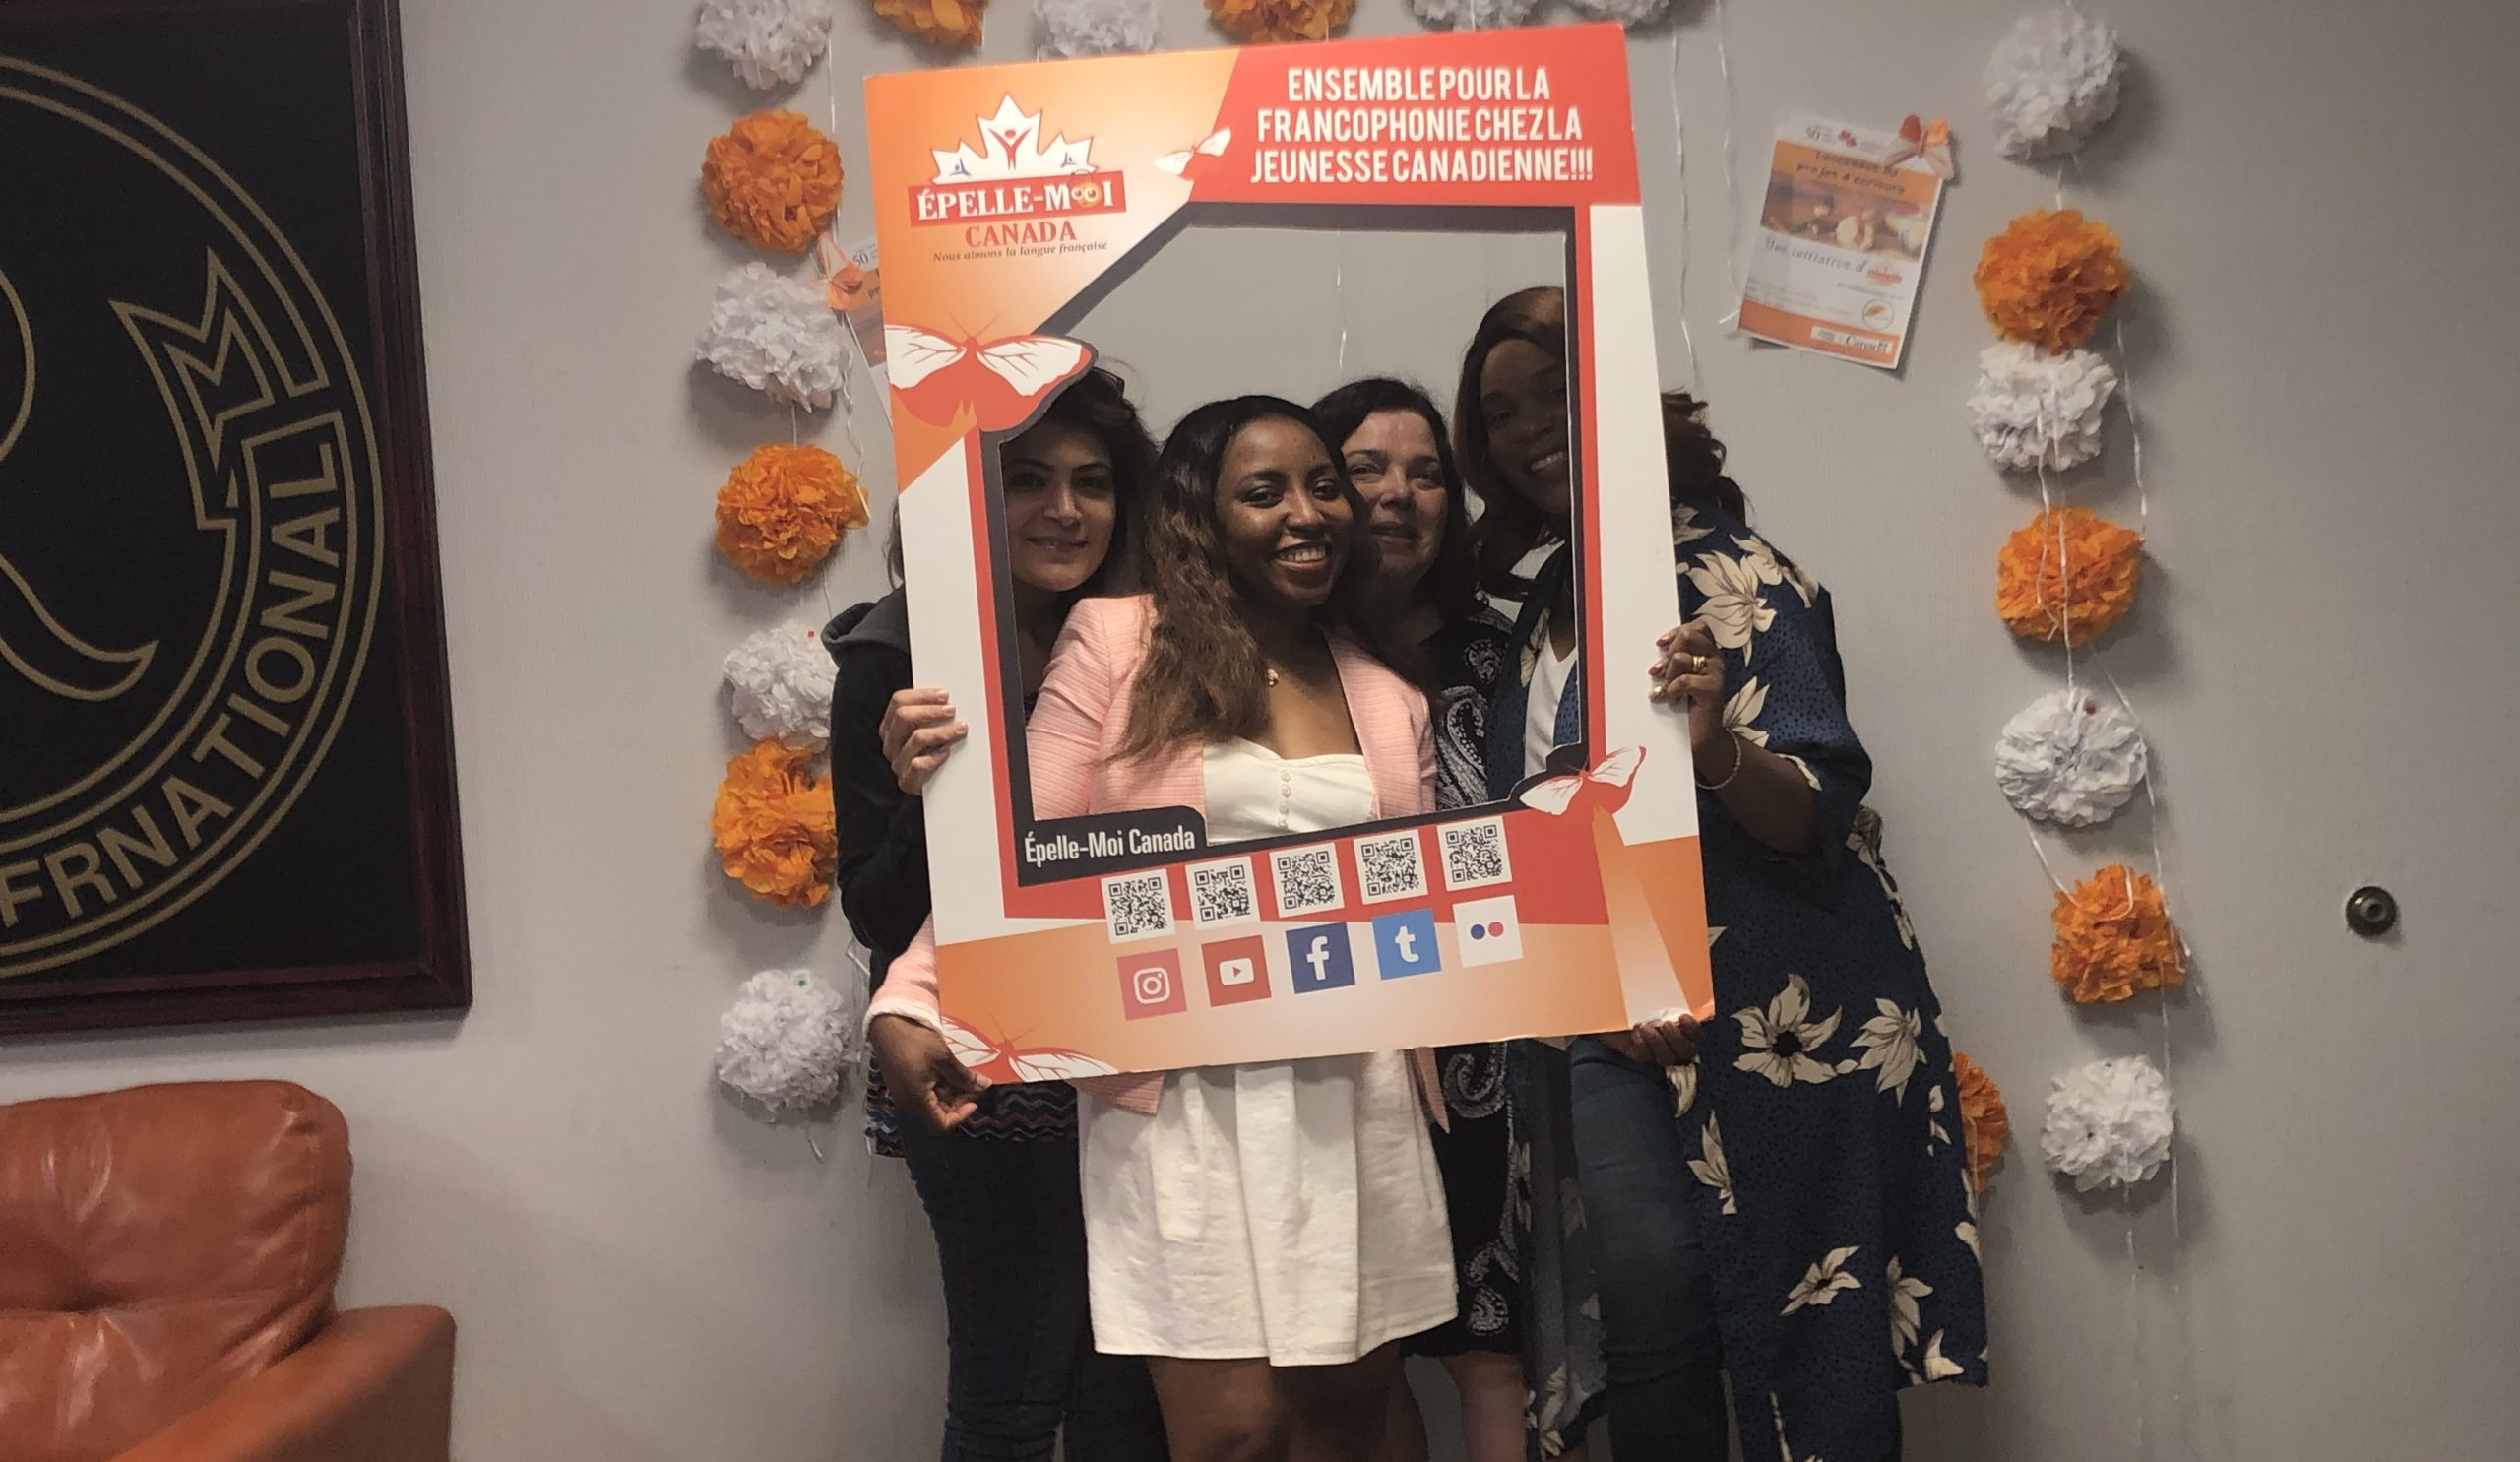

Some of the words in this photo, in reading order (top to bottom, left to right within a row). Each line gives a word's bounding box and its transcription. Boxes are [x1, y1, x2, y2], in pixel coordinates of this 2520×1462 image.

[1288, 67, 1435, 102] ENSEMBLE
[1440, 66, 1512, 101] POUR
[1516, 66, 1550, 101] LA
[1257, 107, 1471, 143] FRANCOPHONIE
[1474, 107, 1544, 141] CHEZ
[1548, 105, 1583, 141] LA
[1250, 149, 1388, 183] JEUNESSE
[1393, 147, 1594, 182] CANADIENNE!!!
[932, 252, 961, 263] Nous
[964, 250, 1002, 261] aimons
[1006, 247, 1016, 257] la
[1020, 245, 1056, 257] langue
[1059, 240, 1108, 256] française
[965, 221, 1077, 248] CANADA
[1024, 830, 1124, 868] Épelle-Moi
[1129, 825, 1195, 855] Canada
